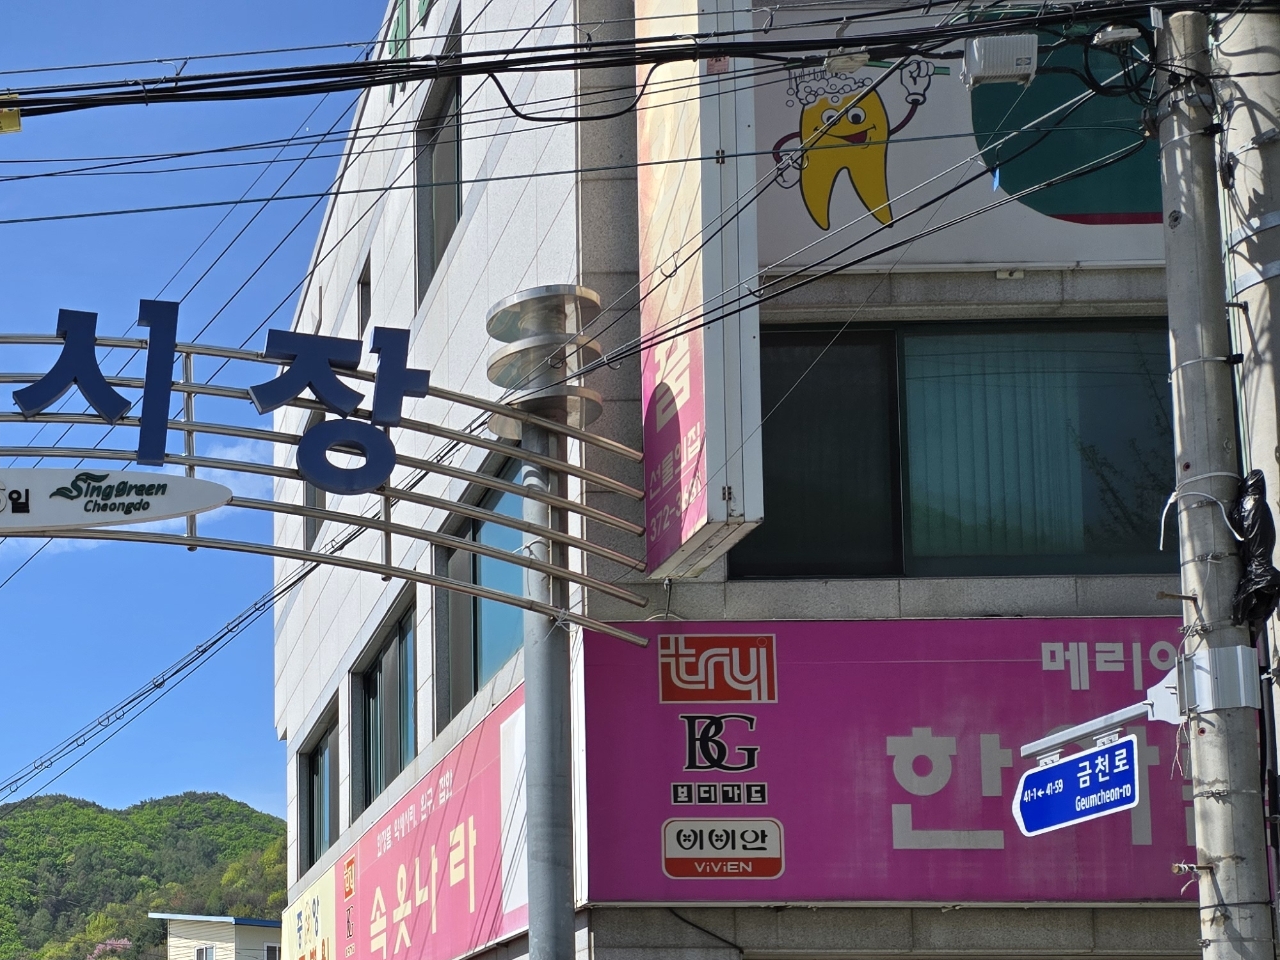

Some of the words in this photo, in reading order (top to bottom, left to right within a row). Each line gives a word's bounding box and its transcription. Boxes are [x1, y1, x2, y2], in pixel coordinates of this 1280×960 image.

[679, 713, 761, 773] BG
[1076, 748, 1130, 789] 금천로
[674, 784, 766, 803] 보디가드
[1075, 783, 1132, 812] Geumcheon-ro
[676, 828, 768, 851] 비비안
[369, 815, 477, 960] 속옷나라
